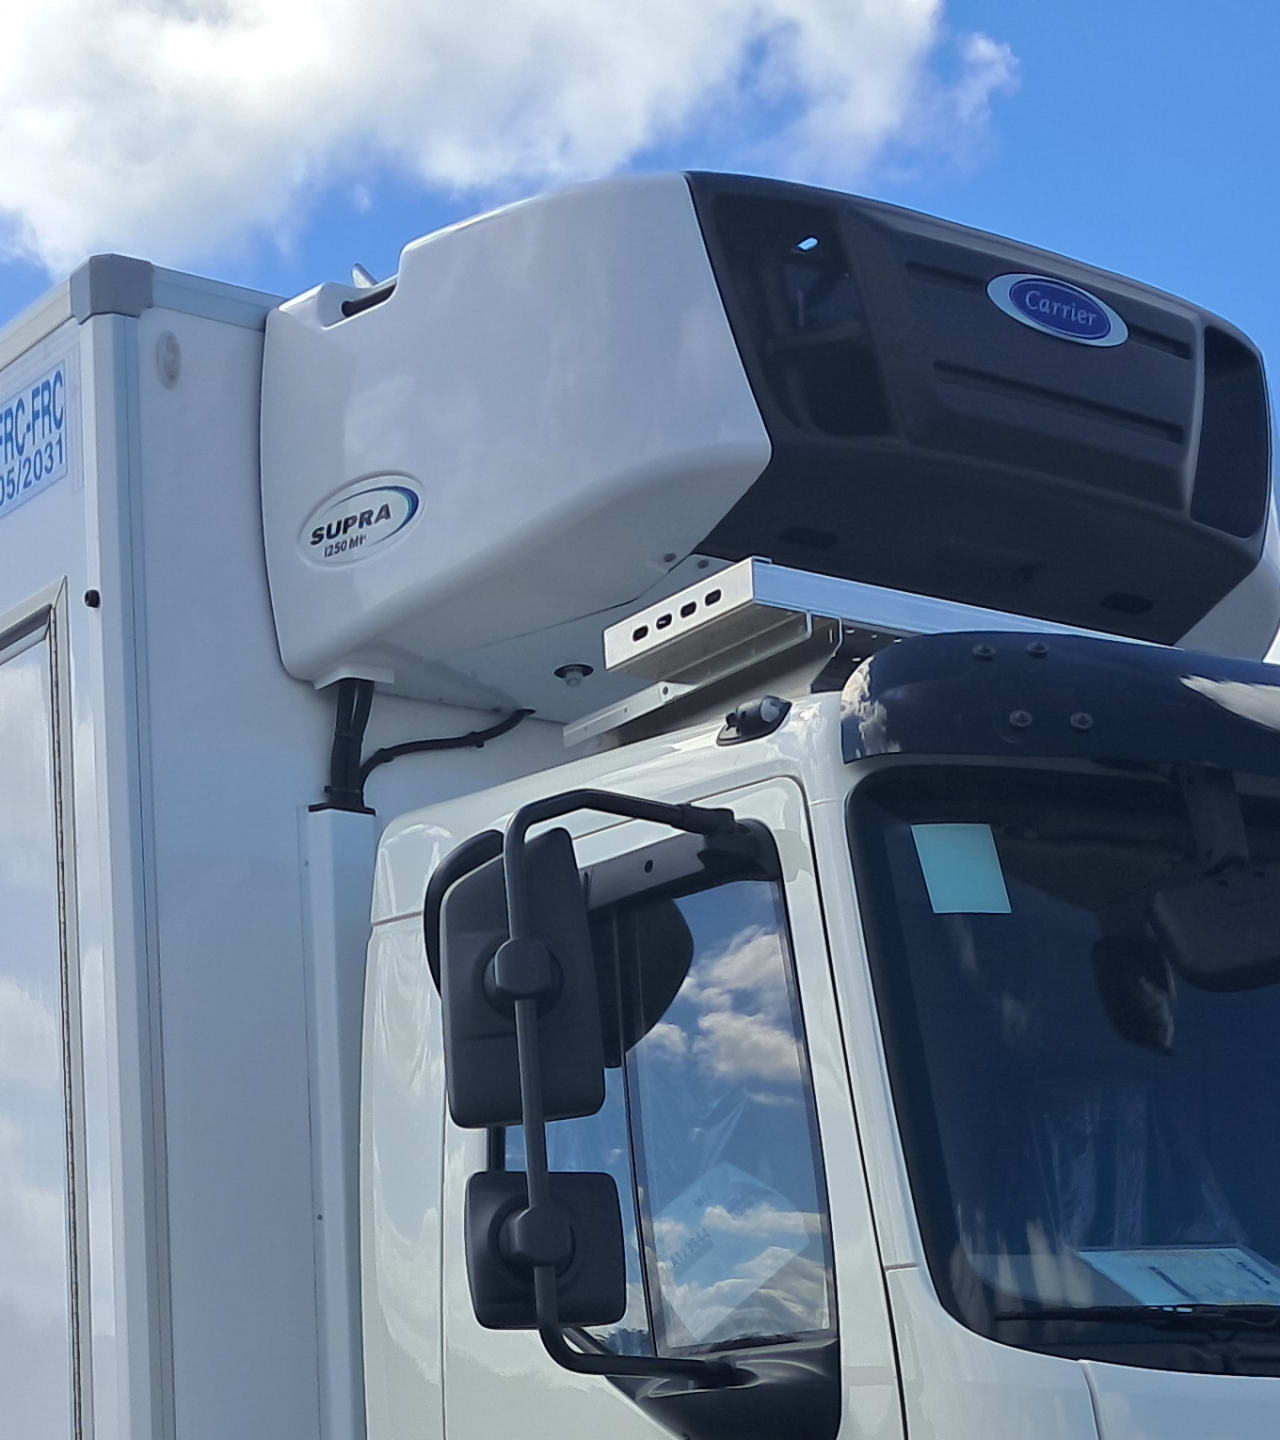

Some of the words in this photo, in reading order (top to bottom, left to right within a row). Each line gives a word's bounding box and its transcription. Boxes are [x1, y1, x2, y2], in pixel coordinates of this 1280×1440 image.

[1024, 290, 1097, 327] Carrier
[310, 503, 392, 546] SUPRA
[323, 540, 347, 558] 1250
